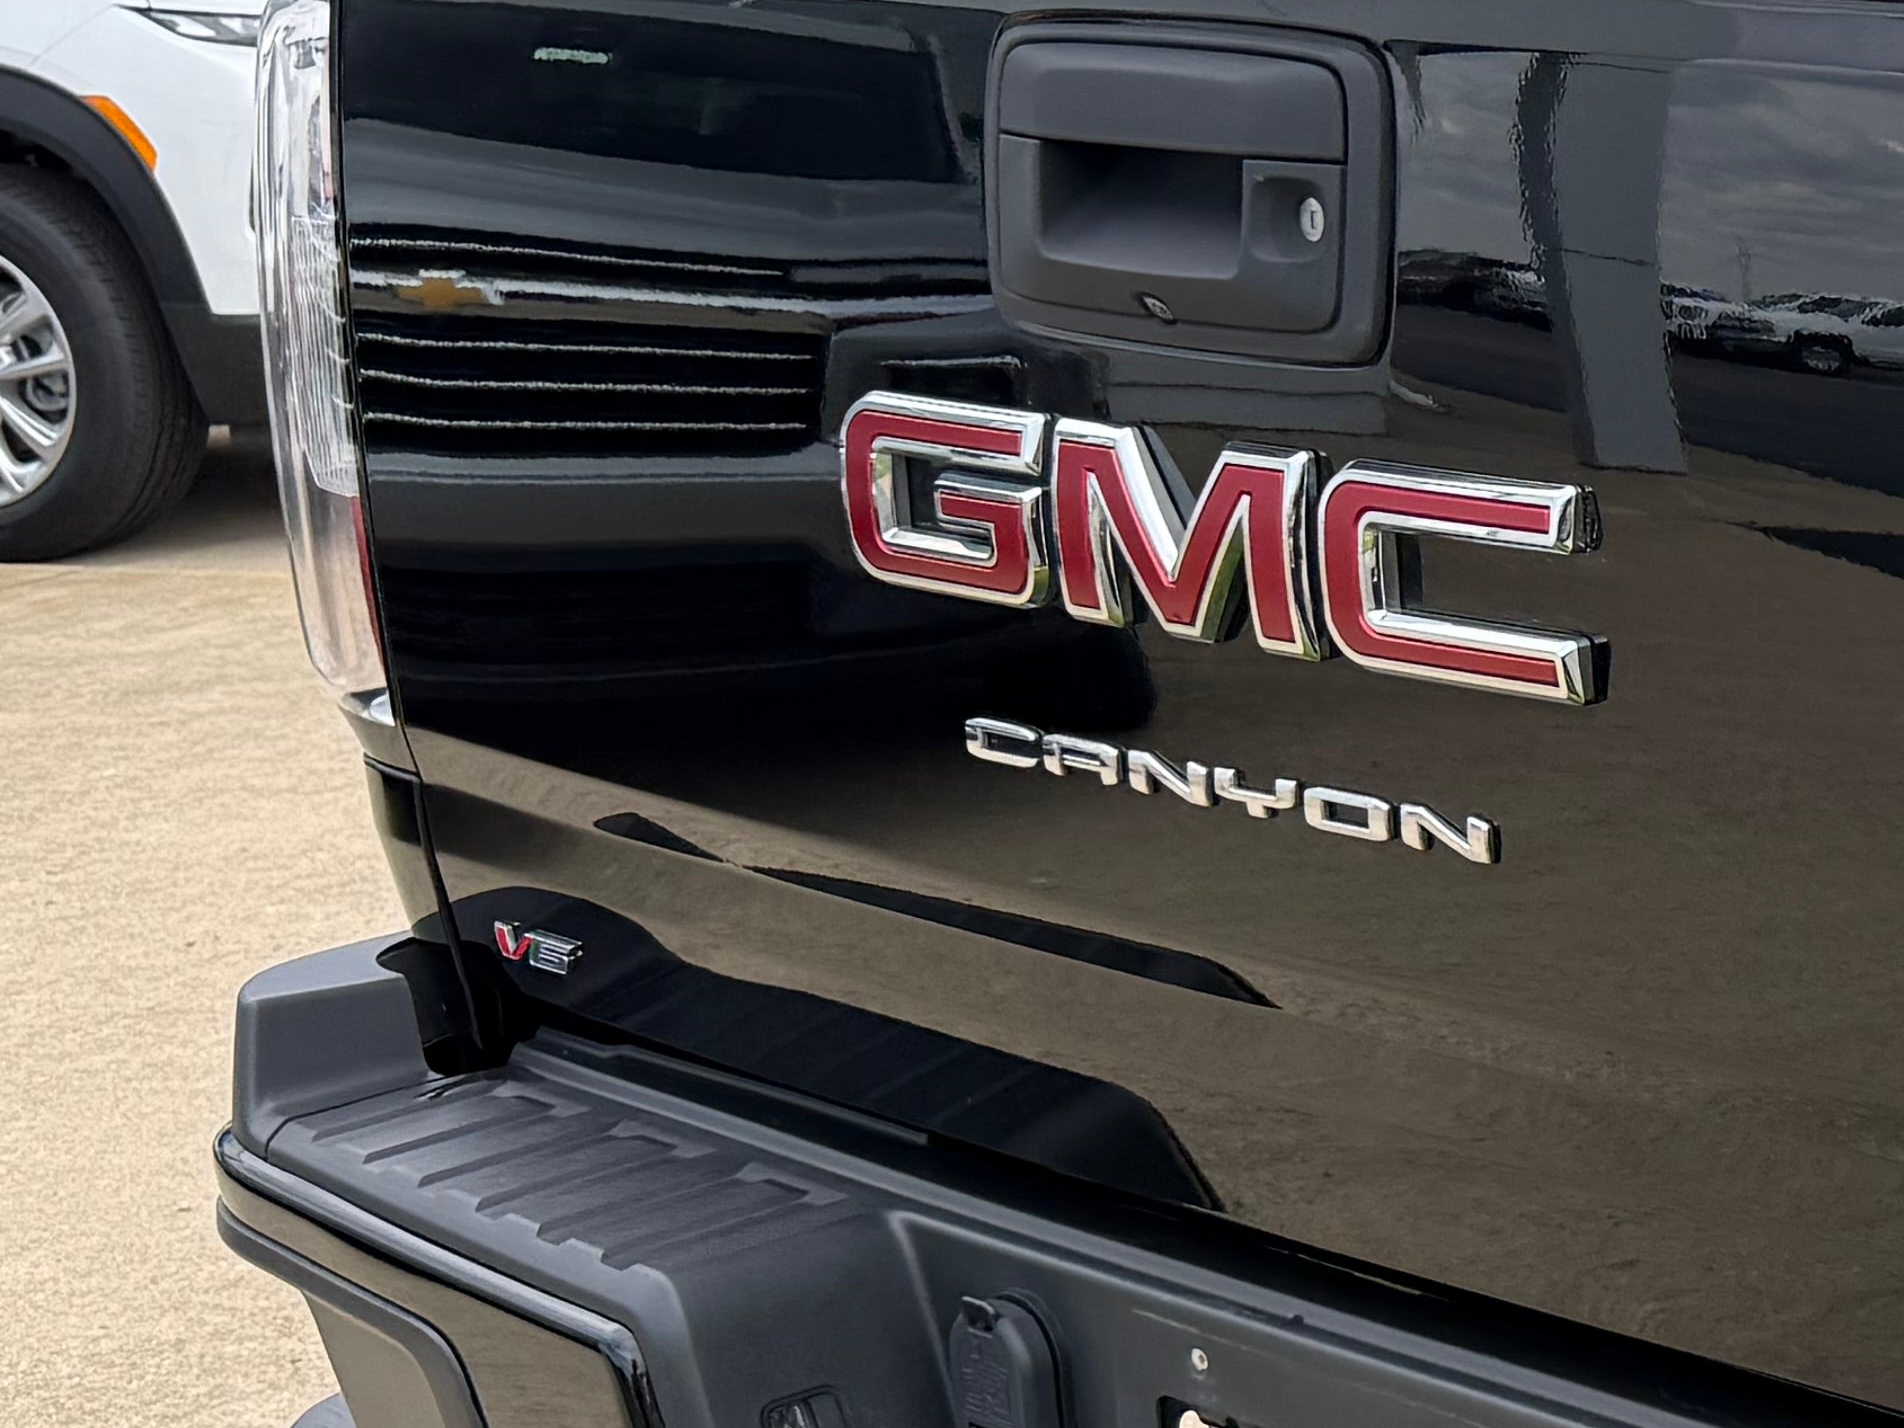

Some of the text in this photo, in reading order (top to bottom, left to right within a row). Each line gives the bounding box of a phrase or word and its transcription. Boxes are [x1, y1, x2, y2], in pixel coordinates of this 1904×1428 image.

[839, 390, 1605, 705] GMC
[964, 716, 1501, 865] CANYON
[494, 920, 583, 974] V6
